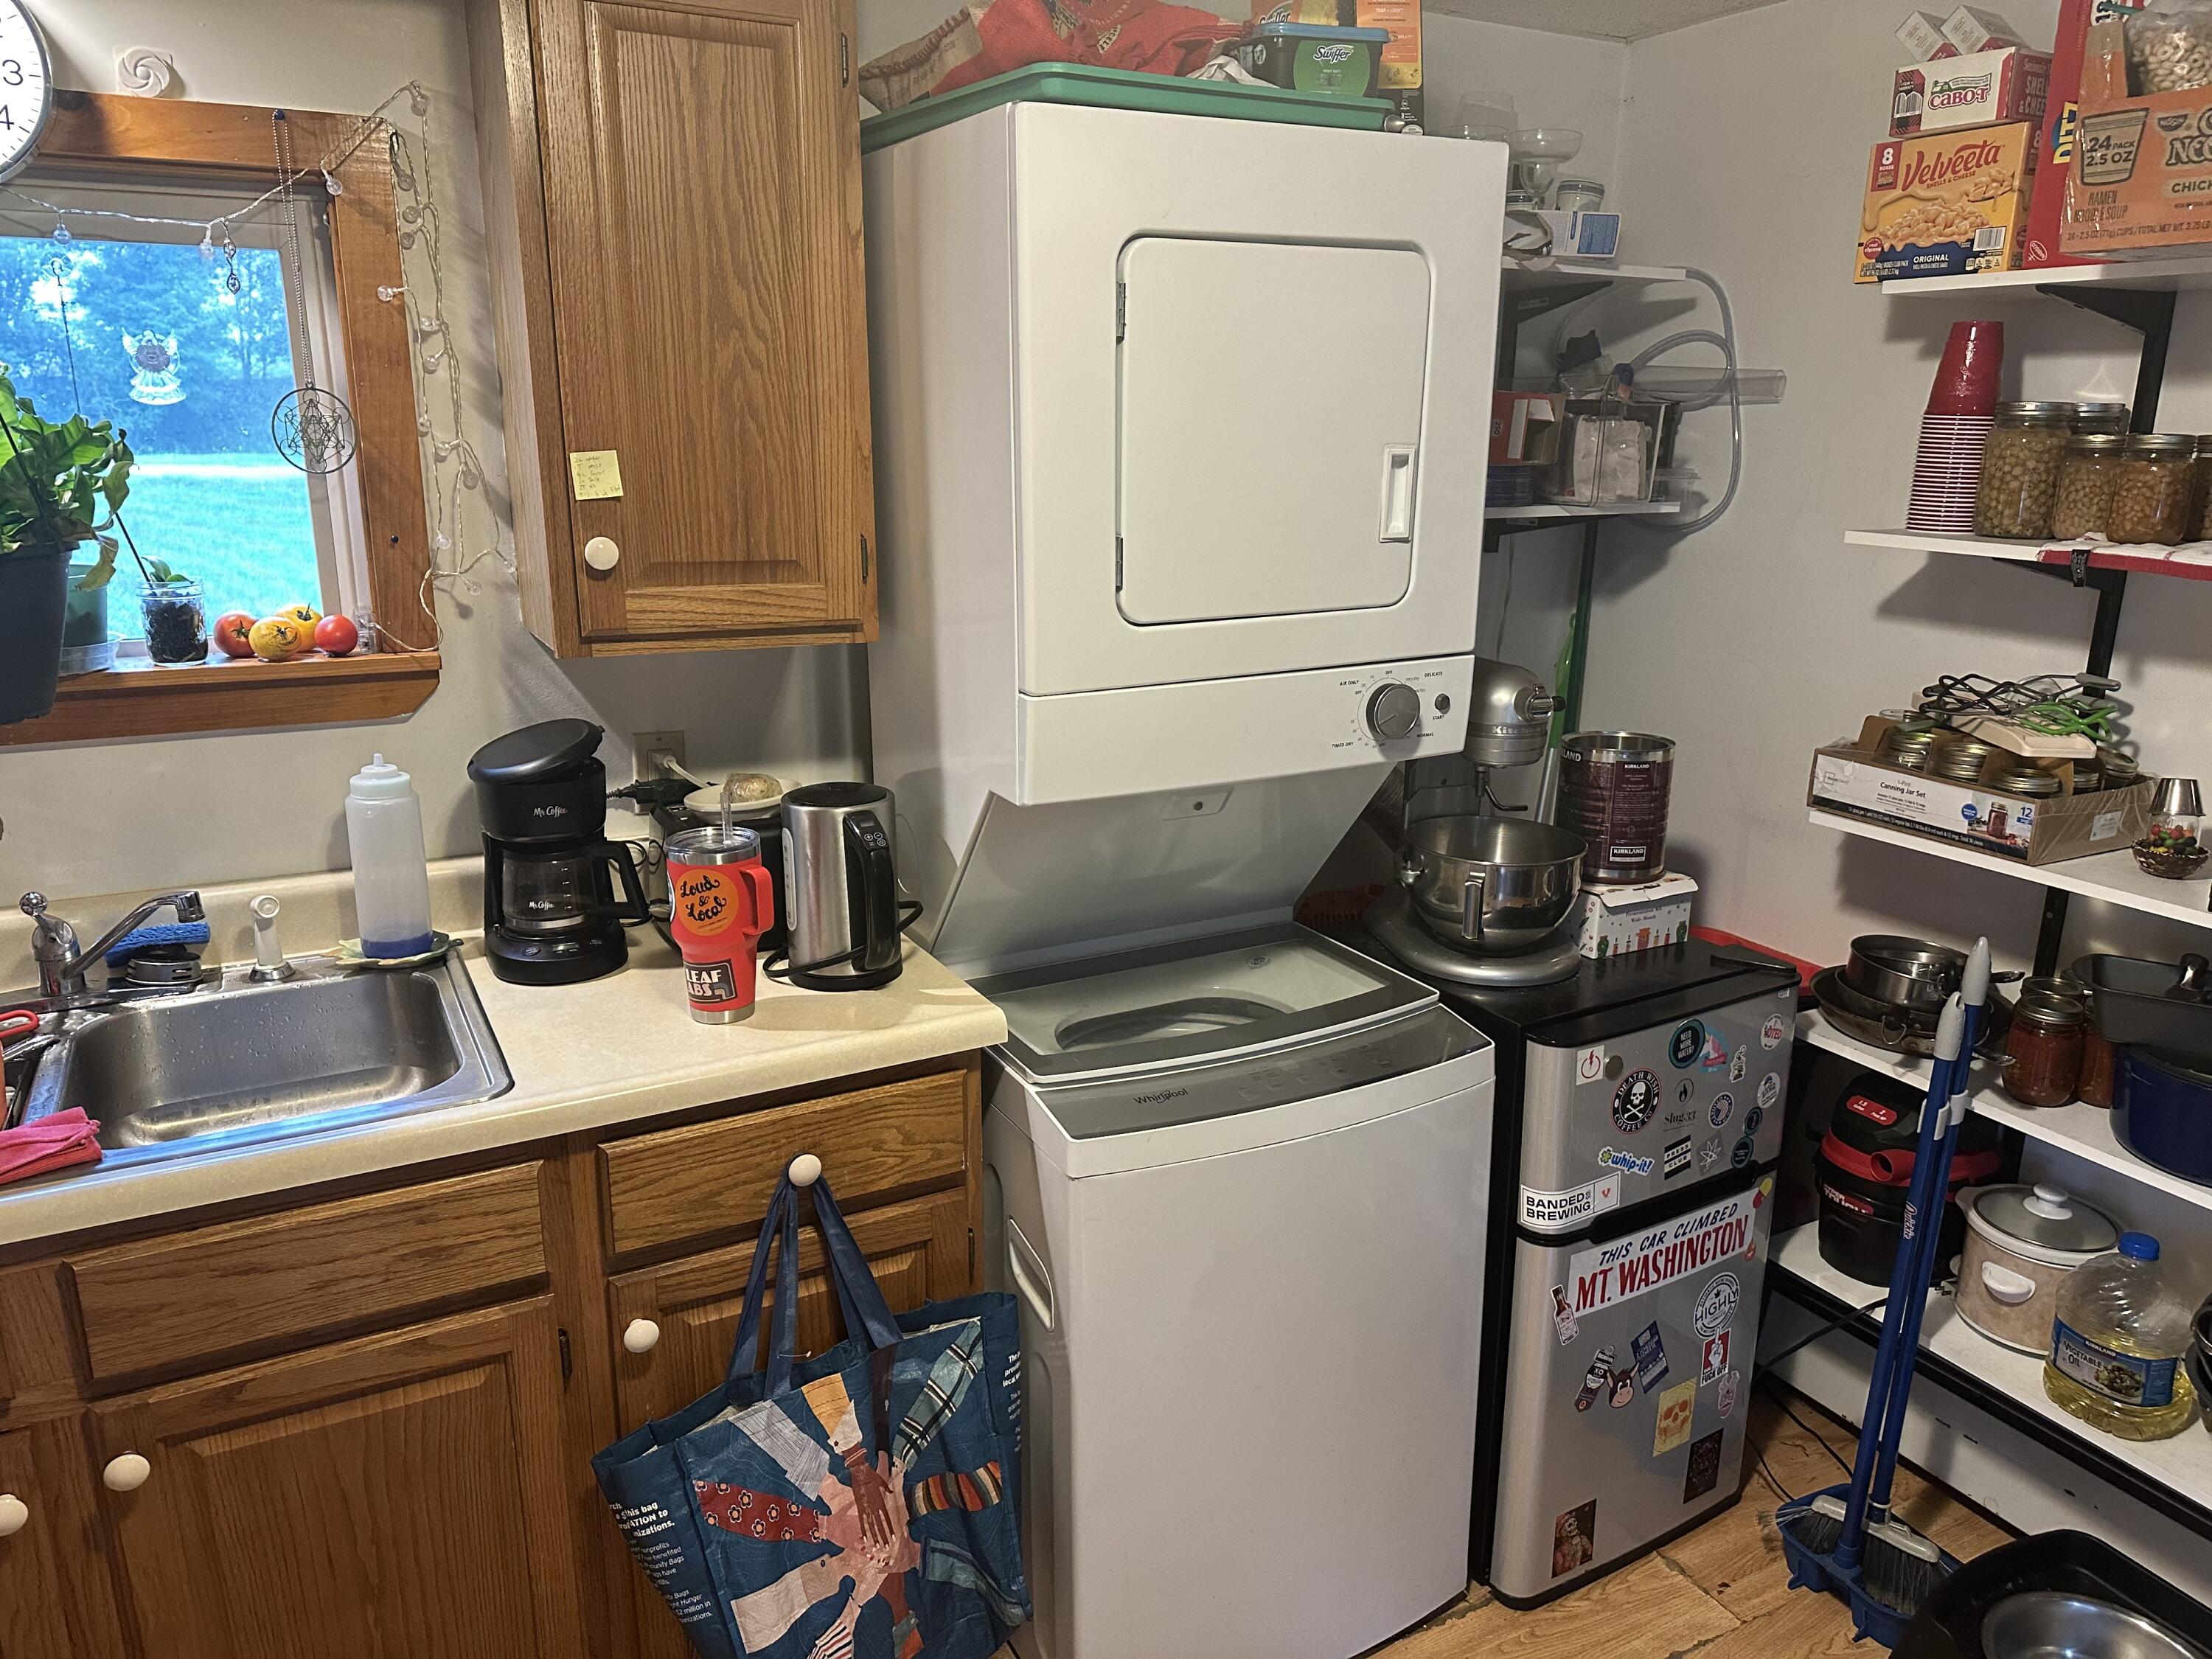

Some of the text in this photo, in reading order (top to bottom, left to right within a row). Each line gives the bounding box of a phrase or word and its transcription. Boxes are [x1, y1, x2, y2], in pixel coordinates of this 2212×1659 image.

[1315, 46, 1351, 63] Swiffer
[2, 60, 23, 86] 3
[0, 105, 15, 131] 4
[2087, 135, 2135, 153] 24 PACK
[1882, 147, 1893, 165] 8
[2086, 151, 2134, 167] 2.5 OZ
[1902, 140, 2002, 192] Velveeta
[1926, 178, 1947, 189] SHELLS
[1953, 170, 1976, 181] CHEESE
[2088, 190, 2118, 204] RAMEN
[2107, 205, 2128, 220] SOUP
[2139, 226, 2157, 234] TOTAL
[1913, 254, 1949, 263] ORIGINAL
[1880, 782, 1905, 794] Canning
[1916, 790, 1926, 798] Set
[546, 806, 568, 818] Coffee
[2020, 807, 2031, 818] 12
[680, 875, 720, 897] Loud
[538, 901, 554, 911] Coffee
[686, 896, 727, 921] Local
[699, 896, 709, 907] &
[685, 968, 721, 983] LEAF
[688, 982, 712, 996] ABS
[1681, 1030, 1691, 1040] NEED
[1680, 1038, 1691, 1050] MORE
[1677, 1046, 1694, 1059] WATER?
[1618, 1071, 1660, 1096] DEATH WISH
[1133, 1088, 1189, 1105] Whirlpool
[1614, 1114, 1642, 1132] COFFEE
[1666, 1144, 1688, 1158] PRESS
[1611, 1154, 1653, 1173] whip-it!
[1669, 1155, 1687, 1167] CLUB
[1527, 1193, 1585, 1209] BANDED
[1527, 1201, 1590, 1220] BREWING
[1904, 1200, 1917, 1239] Quickie
[1599, 1203, 1738, 1266] THIS CAR CLIMBED
[1576, 1214, 1748, 1312] MT. WASHINGTON
[1695, 1287, 1739, 1325] HIGHLY
[2064, 1340, 2102, 1368] VEGETABLE
[2085, 1340, 2116, 1357] KIRKLAND
[2068, 1354, 2080, 1367] OIL
[1003, 1376, 1016, 1387] local
[1702, 1365, 1727, 1385] FUCK OFF
[641, 1502, 658, 1513] bag
[630, 1509, 668, 1527] ATION to
[633, 1520, 675, 1537] nizations.
[641, 1542, 670, 1553] onprofits
[653, 1546, 682, 1559] benefited
[669, 1556, 684, 1565] Bags
[662, 1568, 677, 1576] have
[674, 1590, 689, 1599] Bags
[680, 1594, 703, 1606] Hunger
[681, 1611, 713, 1623] anizations.
[684, 1604, 704, 1615] million
